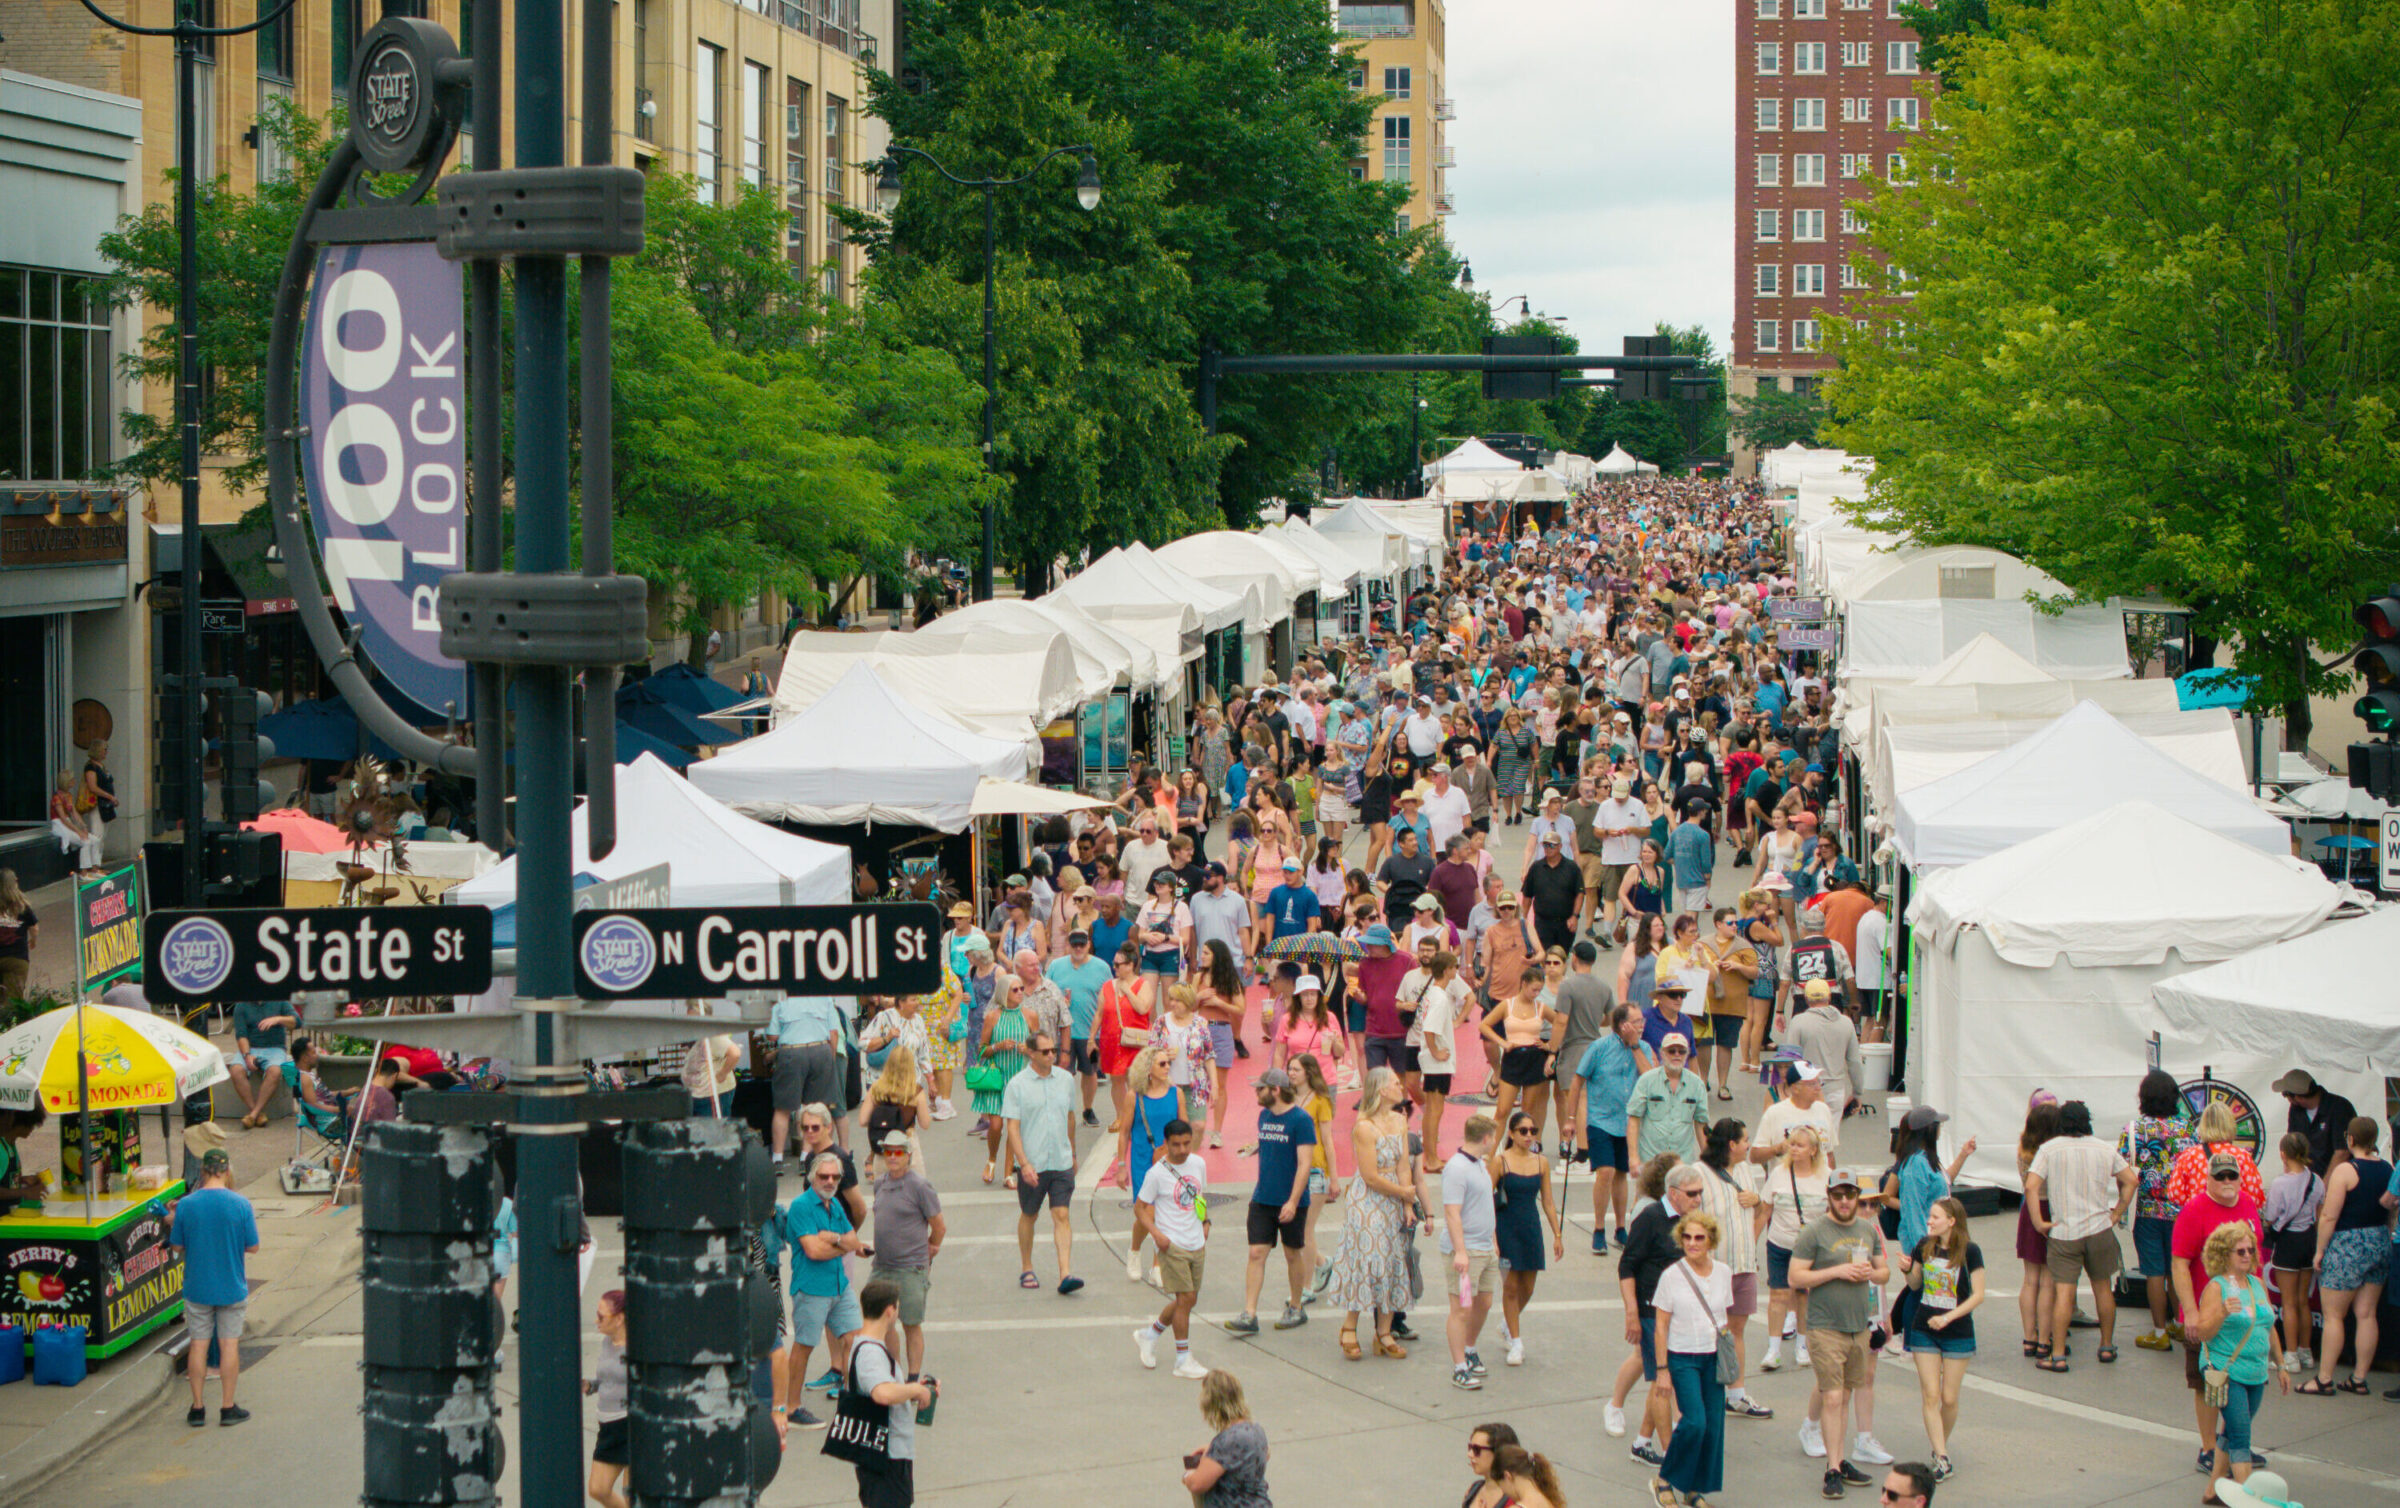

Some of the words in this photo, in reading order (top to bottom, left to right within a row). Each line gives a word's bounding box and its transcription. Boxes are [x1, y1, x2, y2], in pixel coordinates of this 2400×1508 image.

[368, 66, 410, 104] STATE
[368, 99, 408, 129] Street
[322, 269, 404, 612] 100
[410, 331, 458, 631] BLOCK
[4, 528, 28, 552] THE
[31, 526, 81, 552] COOPERS
[84, 525, 126, 549] TAVERN
[202, 610, 227, 631] Rare
[1780, 601, 1813, 612] GUG
[1788, 630, 1824, 641] GUG
[90, 890, 127, 927] CHERRY
[608, 878, 657, 909] Mifflin
[84, 917, 140, 980] LEMONADE
[171, 936, 218, 961] STATE
[256, 916, 411, 983] State
[432, 927, 464, 962] St
[592, 934, 641, 959] STATE
[663, 931, 683, 965] N
[698, 914, 878, 983] Carroll
[895, 926, 927, 962] St
[171, 957, 217, 977] Street
[592, 955, 638, 974] Street
[67, 1081, 168, 1106] LMONADE
[124, 1240, 170, 1284] CHERRY
[108, 1262, 185, 1333] LEMONADE
[830, 1414, 889, 1453] HULE
